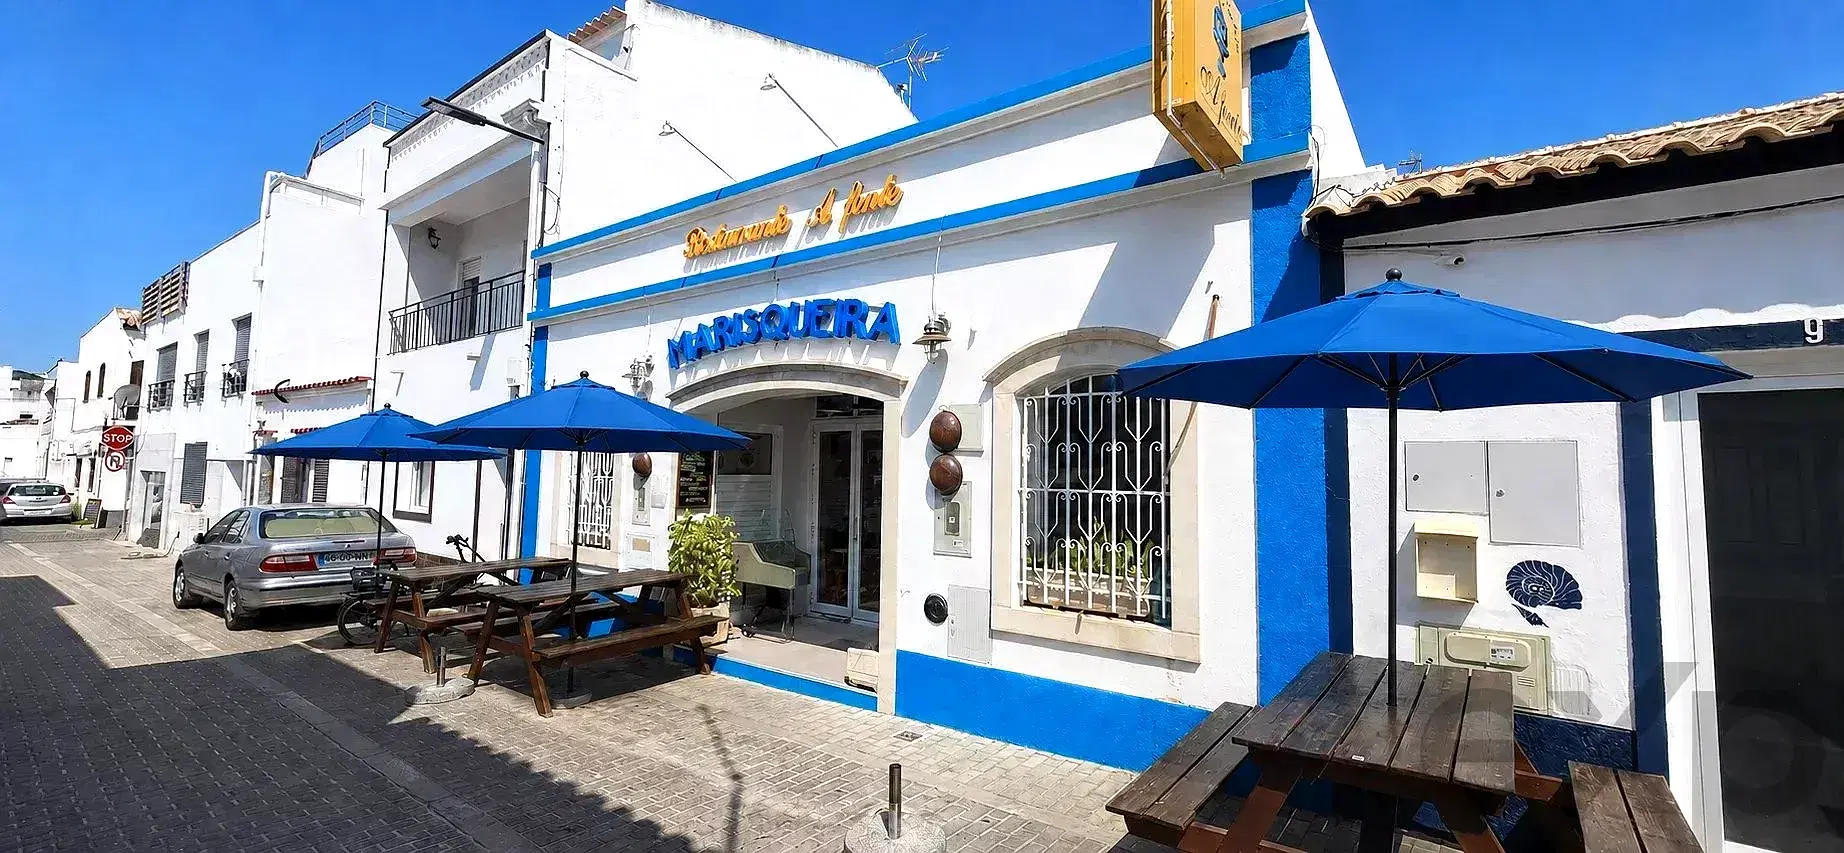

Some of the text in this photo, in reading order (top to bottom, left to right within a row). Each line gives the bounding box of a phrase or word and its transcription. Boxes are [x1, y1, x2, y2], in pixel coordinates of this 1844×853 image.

[683, 204, 791, 257] Restaurante
[667, 298, 901, 369] MARISQUEIRA
[1804, 317, 1824, 344] 9
[103, 433, 134, 443] STOP
